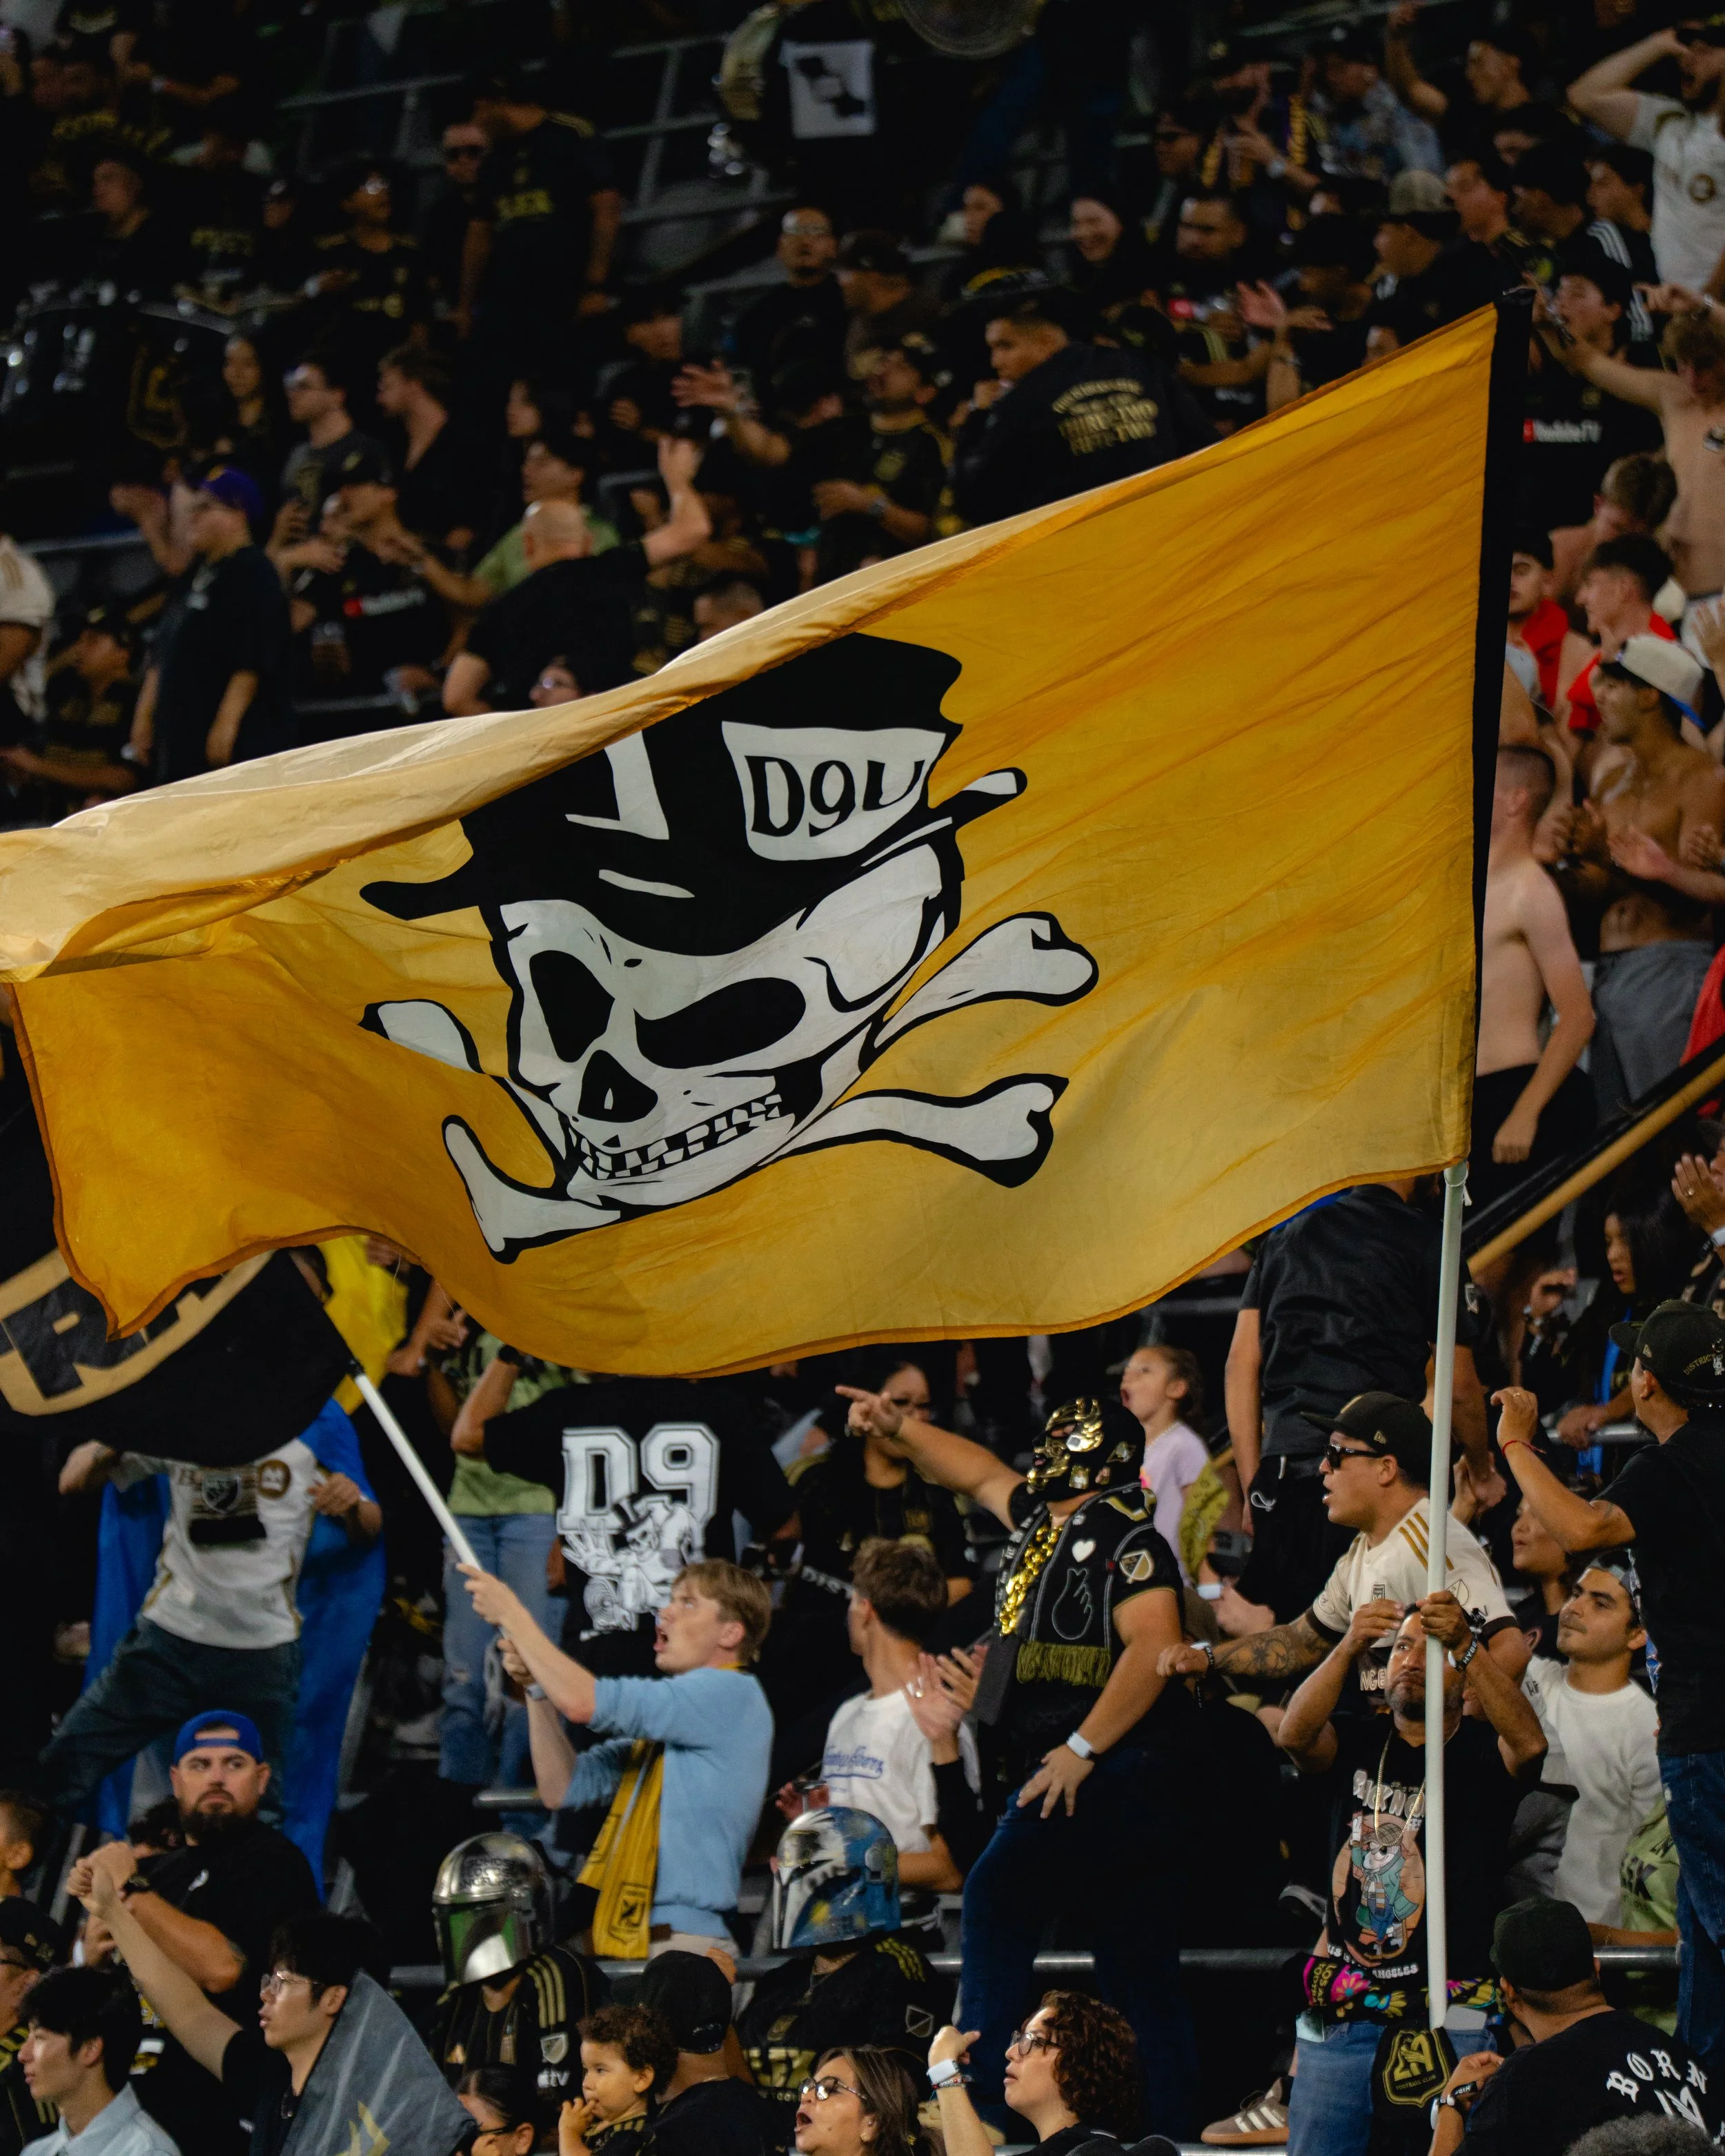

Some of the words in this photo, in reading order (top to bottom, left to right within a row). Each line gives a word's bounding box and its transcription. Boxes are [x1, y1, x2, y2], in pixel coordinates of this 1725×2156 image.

[745, 755, 925, 838] D9U
[556, 1421, 721, 1540] D9
[1462, 1641, 1477, 1664] HYBE
[1371, 1961, 1419, 1980] ANGELES
[1606, 2048, 1708, 2104] BORN
